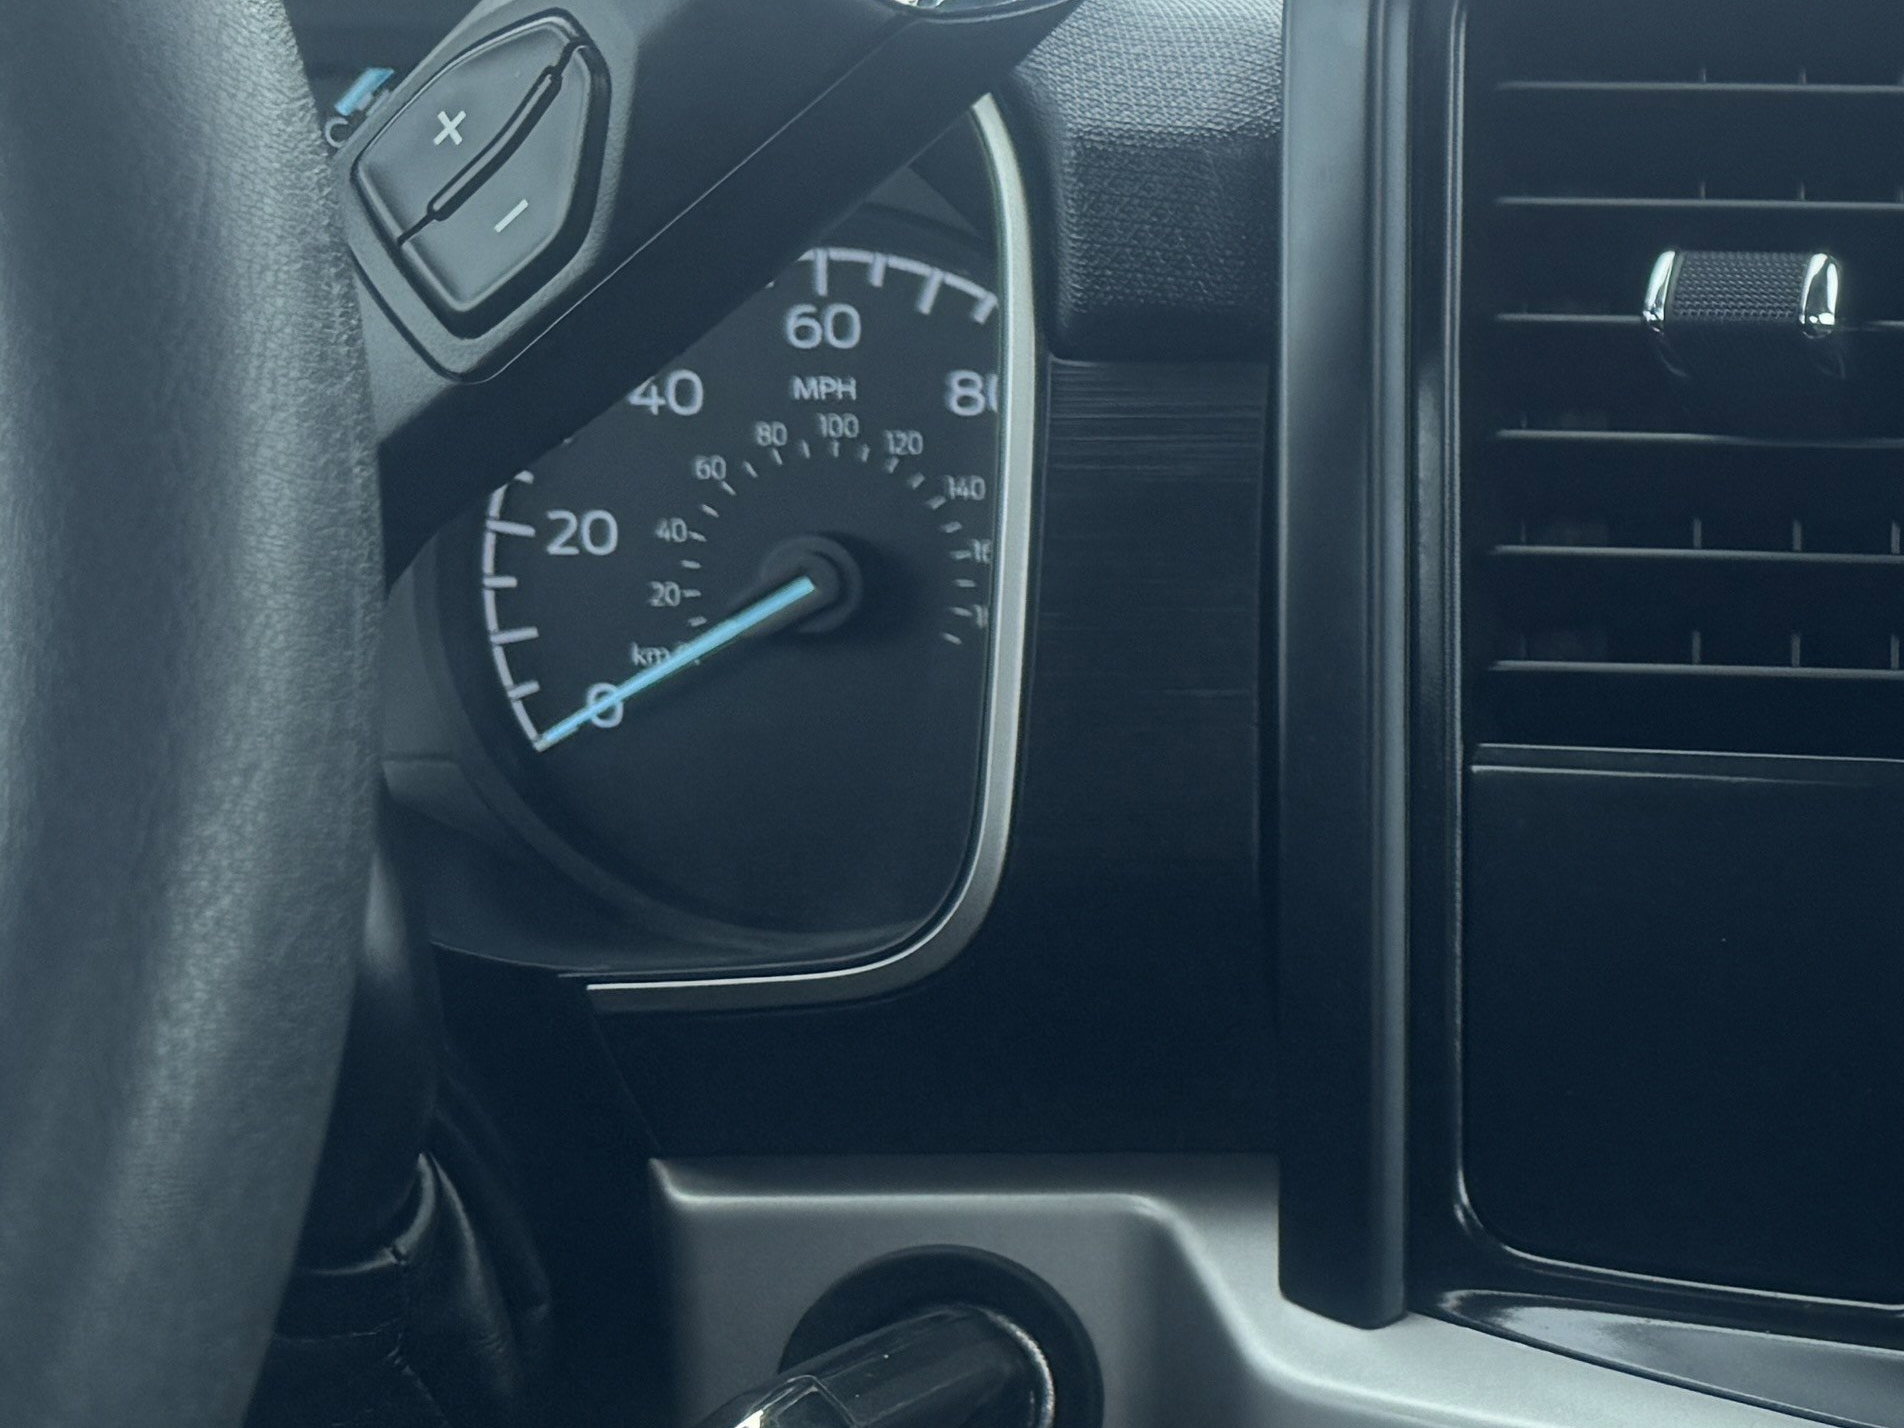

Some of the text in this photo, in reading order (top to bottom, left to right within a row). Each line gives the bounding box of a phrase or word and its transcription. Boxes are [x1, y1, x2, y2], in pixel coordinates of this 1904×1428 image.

[785, 303, 861, 349] 60
[627, 370, 704, 416] 40
[793, 376, 856, 400] MPH
[945, 370, 998, 416] 8
[755, 421, 787, 448] 80
[817, 413, 859, 440] 100
[883, 430, 923, 455] 120
[694, 456, 727, 481] 60
[547, 510, 618, 555] 20
[655, 518, 688, 544] 40
[649, 581, 681, 607] 20
